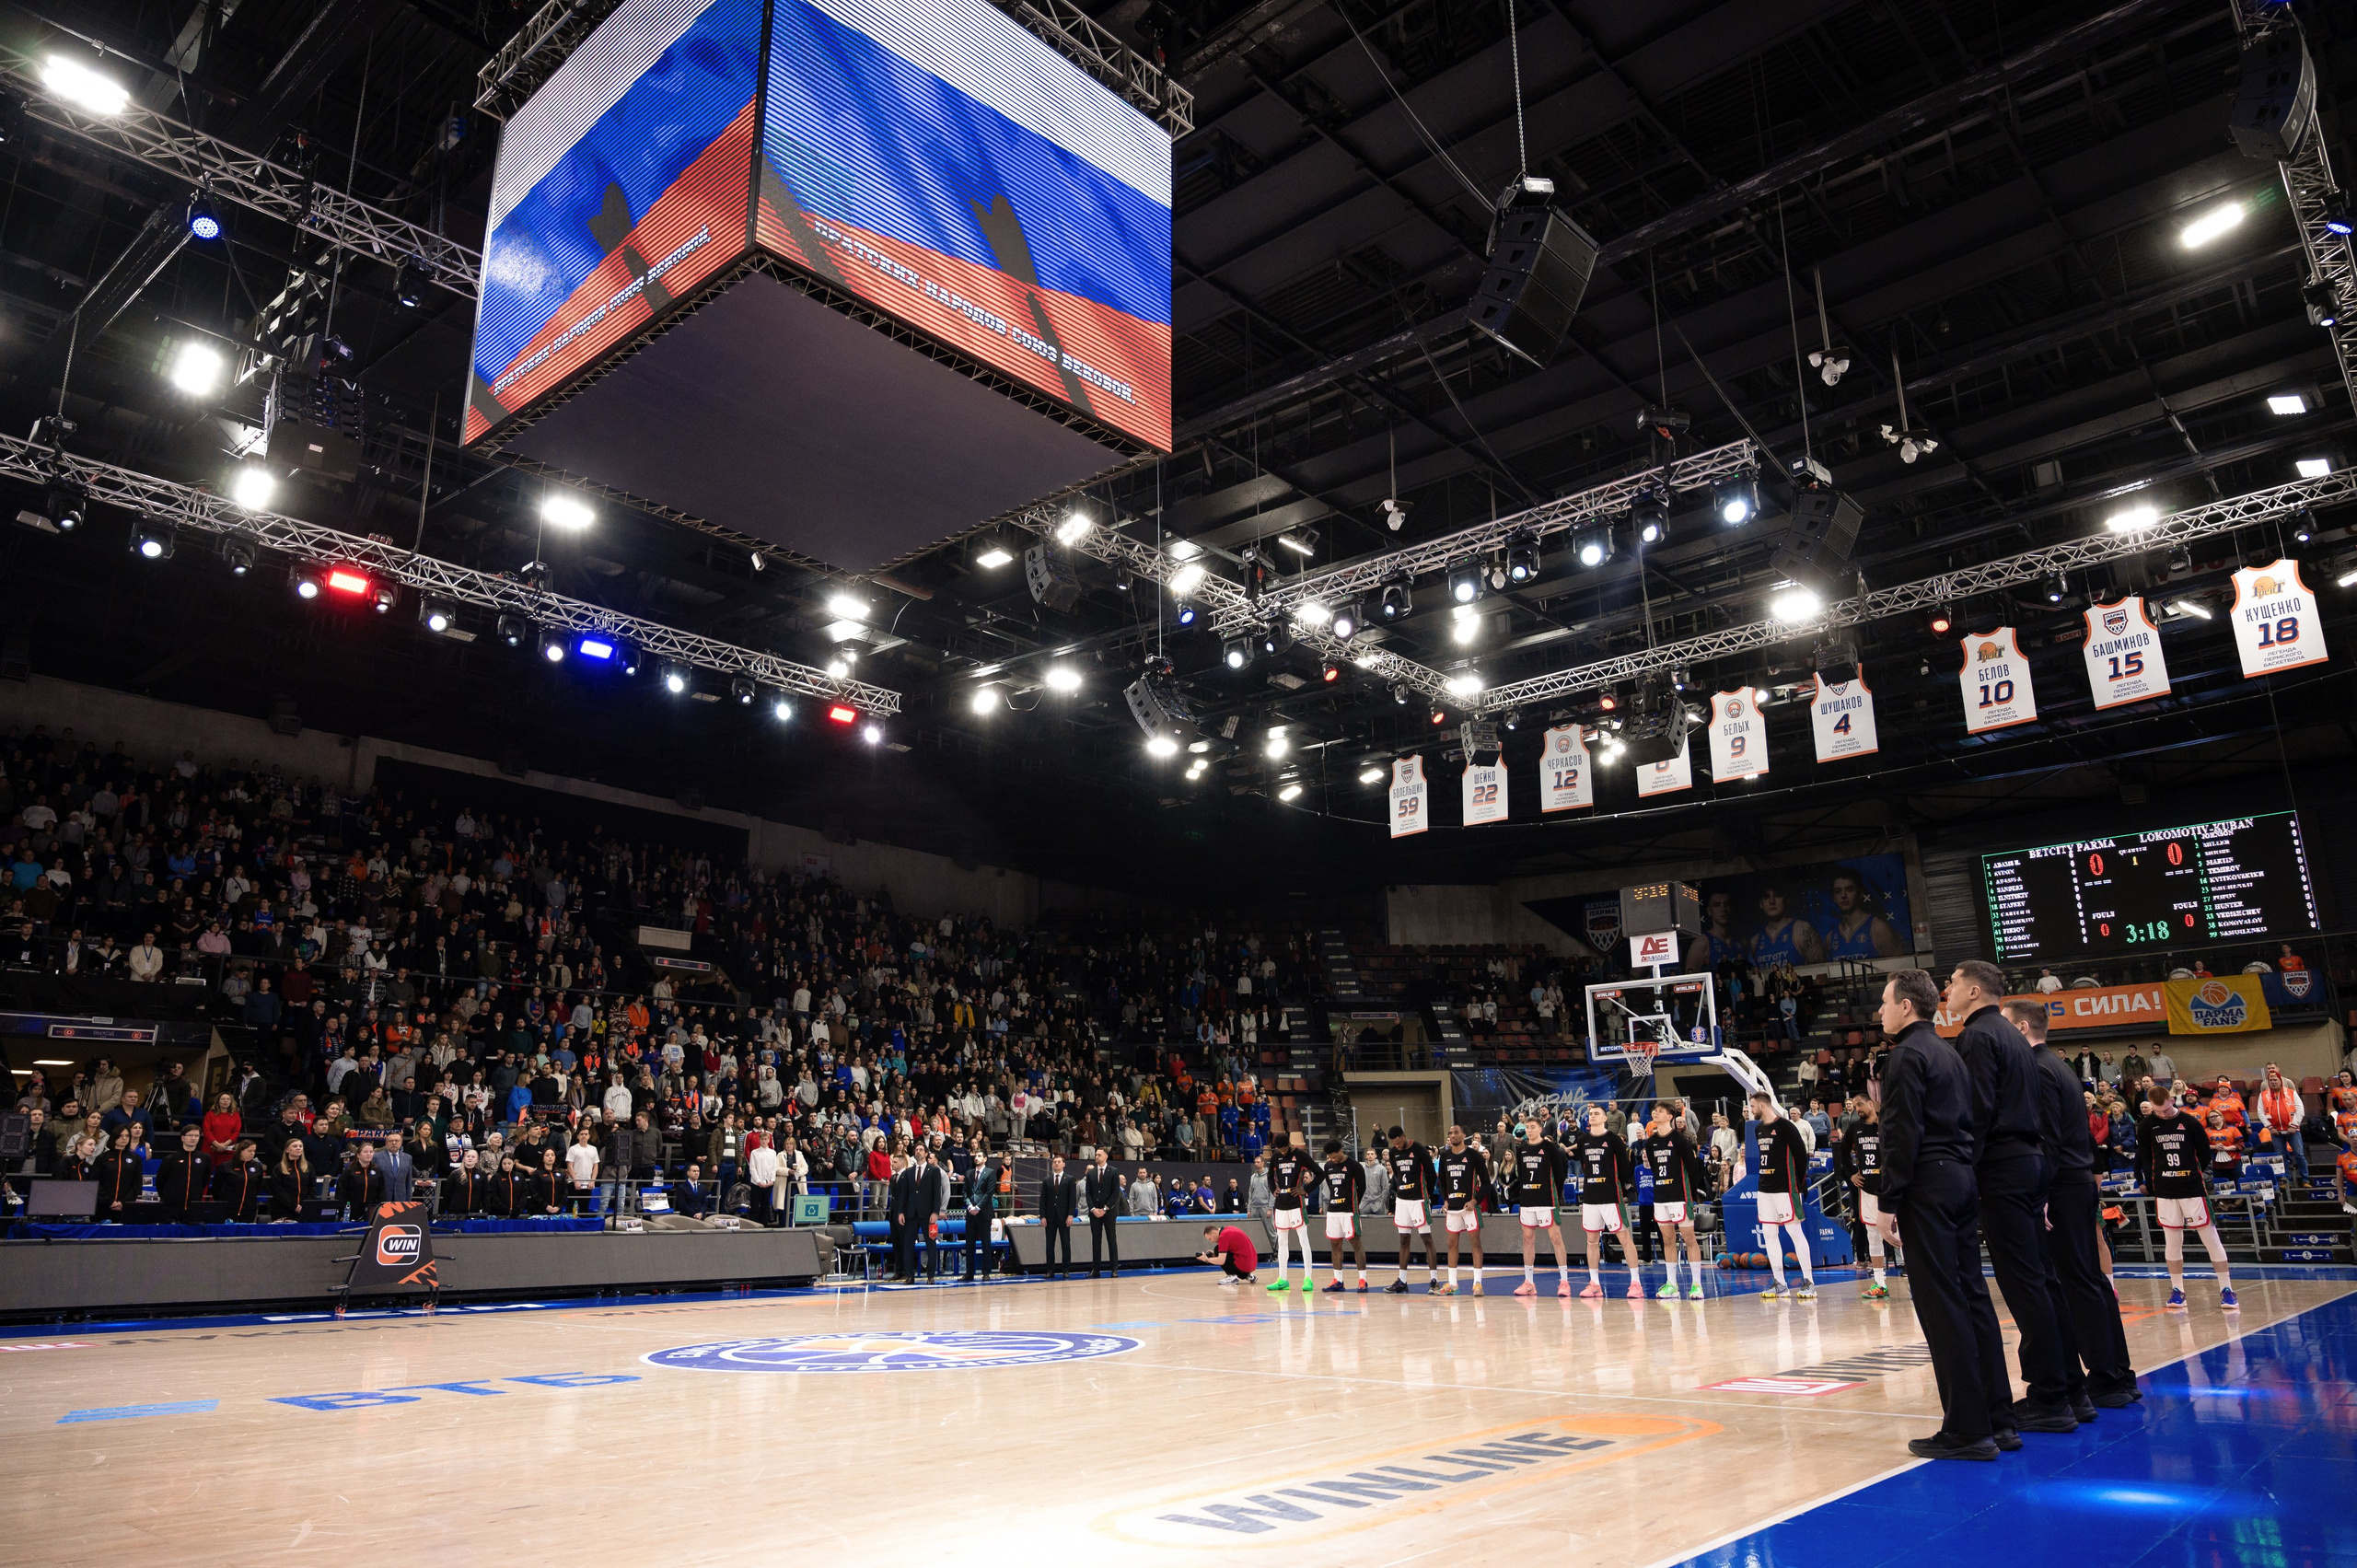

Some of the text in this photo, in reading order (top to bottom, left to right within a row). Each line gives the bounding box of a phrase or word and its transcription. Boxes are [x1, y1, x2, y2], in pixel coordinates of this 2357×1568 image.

[814, 220, 921, 289] БРАТСКИХ
[925, 280, 1007, 335] НАРОДОВ
[1012, 326, 1058, 364] СОЮЗ
[2246, 598, 2301, 622] КУЩЕНКО
[2258, 617, 2299, 650] 18
[2093, 633, 2150, 657] БАШМИНОВ
[2268, 646, 2296, 656] ЛЕГЕНДА
[2264, 651, 2302, 662] ПЕРМСКОГО
[2264, 656, 2305, 668] БАСКЕТБОЛА
[1979, 664, 2009, 681] БЕЛОВ
[2108, 651, 2144, 682] 15
[2114, 683, 2146, 693] ПЕРМСКОГО
[2117, 679, 2142, 689] ЛЕГЕНДА
[1980, 679, 2014, 709] 10
[2113, 687, 2149, 699] БАСКЕТБОЛА
[1820, 696, 1862, 714] ШУШАКОВ
[1988, 706, 2012, 714] ЛЕГЕНДА
[1984, 714, 2018, 725] БАСКЕТБОЛА
[1985, 710, 2015, 719] ПЕРМСКОГО
[1724, 720, 1749, 736] БЕЛЫХ
[1833, 714, 1851, 736] 4
[1731, 736, 1746, 758] 9
[1831, 745, 1861, 753] БАСКЕТБОЛА
[1548, 754, 1582, 770] ЧЕРКАСОВ
[1474, 771, 1495, 784] ШЕЙКО
[1553, 769, 1578, 791] 12
[1393, 783, 1423, 798] БОЛЕЛЬЩИК
[1472, 784, 1498, 807] 22
[1399, 796, 1419, 818] 59
[2140, 818, 2254, 843] LOKOMOTIV-KUBAN
[2028, 839, 2116, 859] BETCITY PARMA
[2167, 842, 2183, 865] 0
[2089, 854, 2104, 876] 0
[2132, 856, 2139, 865] 1
[2173, 901, 2198, 910] FOULS
[1589, 909, 1616, 917] ПАРМА
[2184, 913, 2194, 927] 0
[2100, 923, 2109, 936] 0
[2126, 921, 2169, 943] 3:18
[2074, 991, 2161, 1016] СИЛА!
[2194, 1006, 2245, 1019] ПАРМА
[2203, 1016, 2238, 1027] FANS
[2155, 1134, 2185, 1143] LOKOMOTIV
[1760, 1155, 1768, 1166] 27
[1865, 1155, 1875, 1166] 32
[2166, 1154, 2180, 1167] 99
[1592, 1164, 1599, 1174] 16
[1659, 1166, 1666, 1176] 23
[1284, 1177, 1288, 1186] 1
[1402, 1174, 1407, 1183] 4
[1529, 1171, 1534, 1181] 7
[1453, 1179, 1457, 1190] 5
[1334, 1187, 1339, 1197] 2
[1819, 1227, 1834, 1236] PARMA
[389, 1239, 417, 1250] WIN
[261, 1303, 547, 1322] PERM
[586, 1303, 794, 1318] WINLINE
[666, 1340, 767, 1359] ЕДИНАЯ
[773, 1332, 886, 1343] ЛИГА
[904, 1354, 1074, 1369] UNITED
[265, 1371, 643, 1411] ВТБ
[1155, 1431, 1617, 1535] WINLINE
